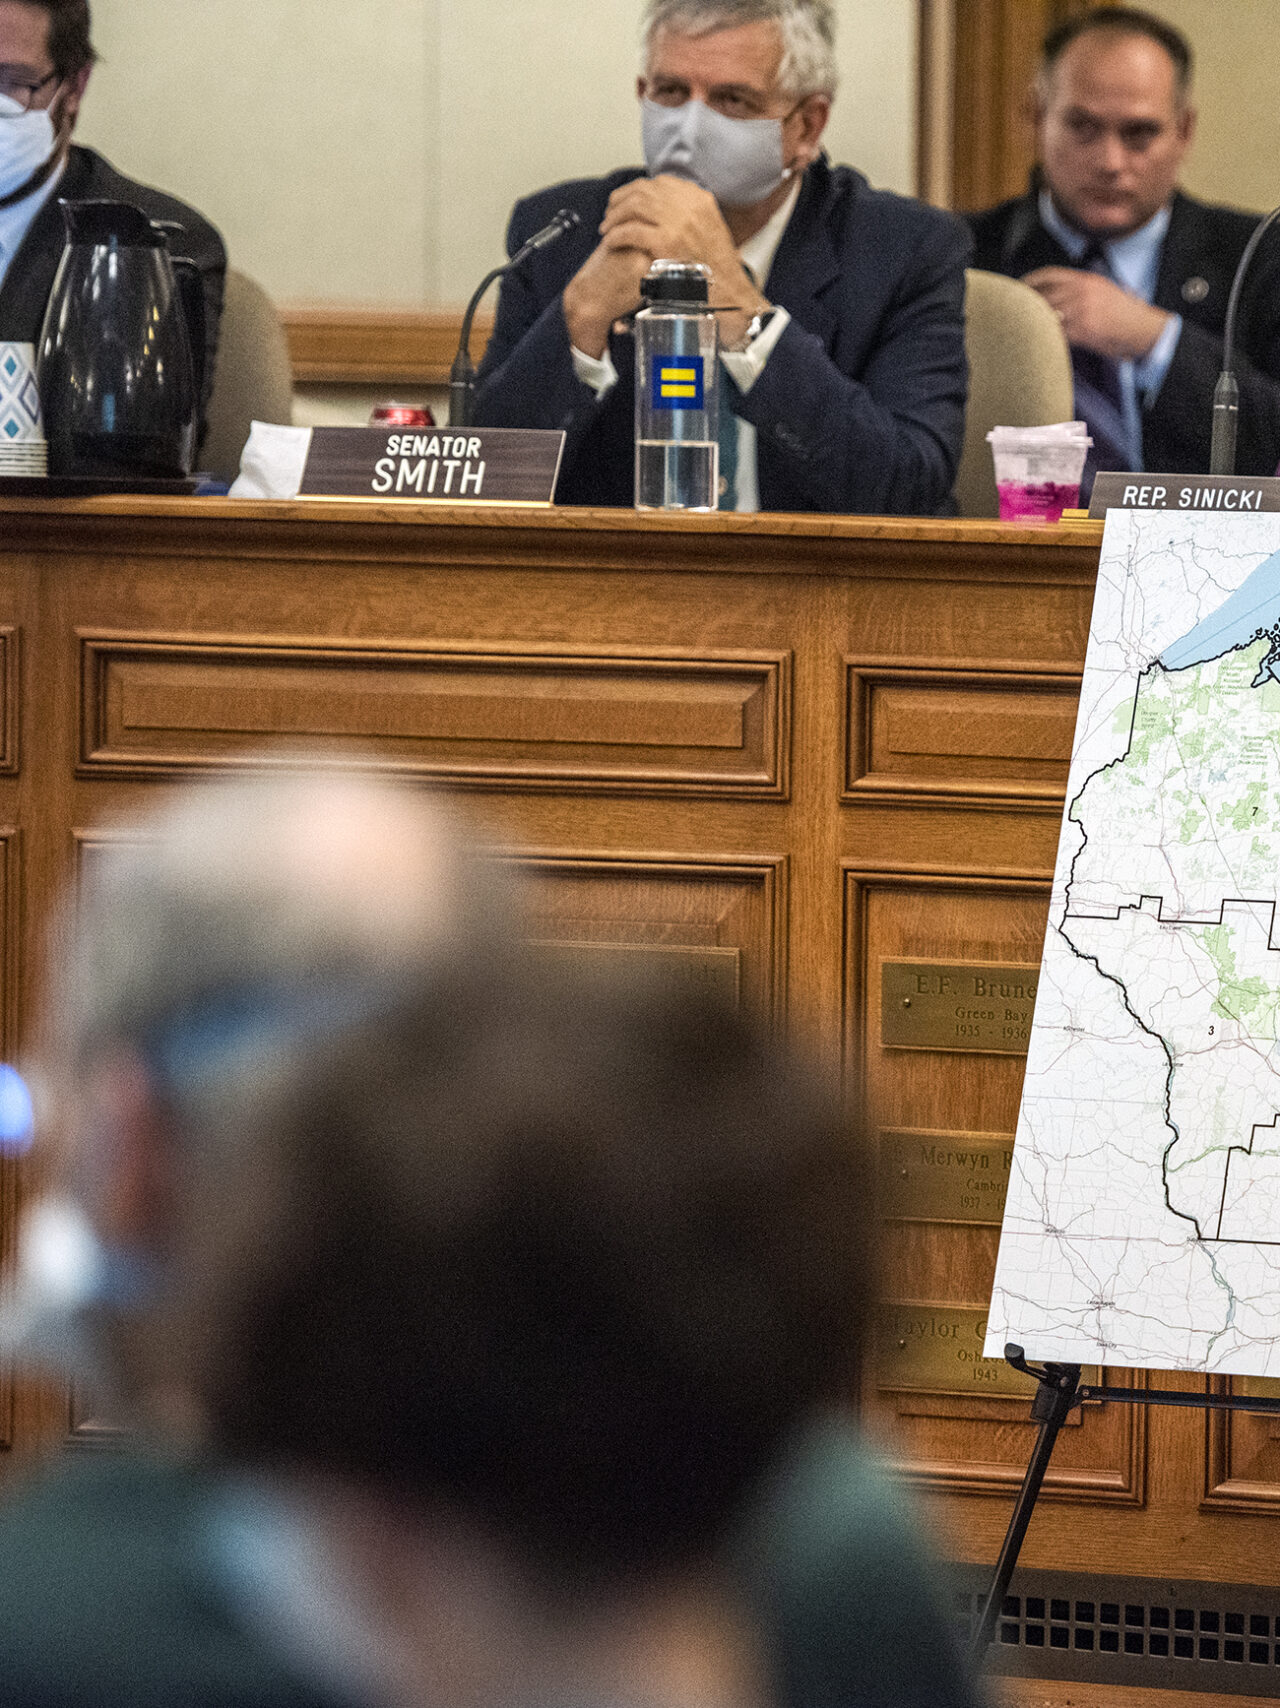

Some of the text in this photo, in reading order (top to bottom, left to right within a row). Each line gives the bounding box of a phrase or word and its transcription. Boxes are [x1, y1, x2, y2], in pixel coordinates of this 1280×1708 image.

[386, 434, 482, 458] SENATOR
[371, 457, 486, 495] SMITH
[1122, 485, 1263, 510] REP. SINICKI
[1252, 806, 1259, 817] 7
[913, 973, 959, 996] E.F.
[955, 1006, 1029, 1025] Green Bay
[955, 1024, 981, 1038] 1935
[1002, 1026, 1028, 1040] 1936
[1208, 1025, 1215, 1036] 3
[921, 1144, 989, 1172] Merwyn
[893, 1312, 960, 1340] aylor
[972, 1368, 999, 1382] 1943
